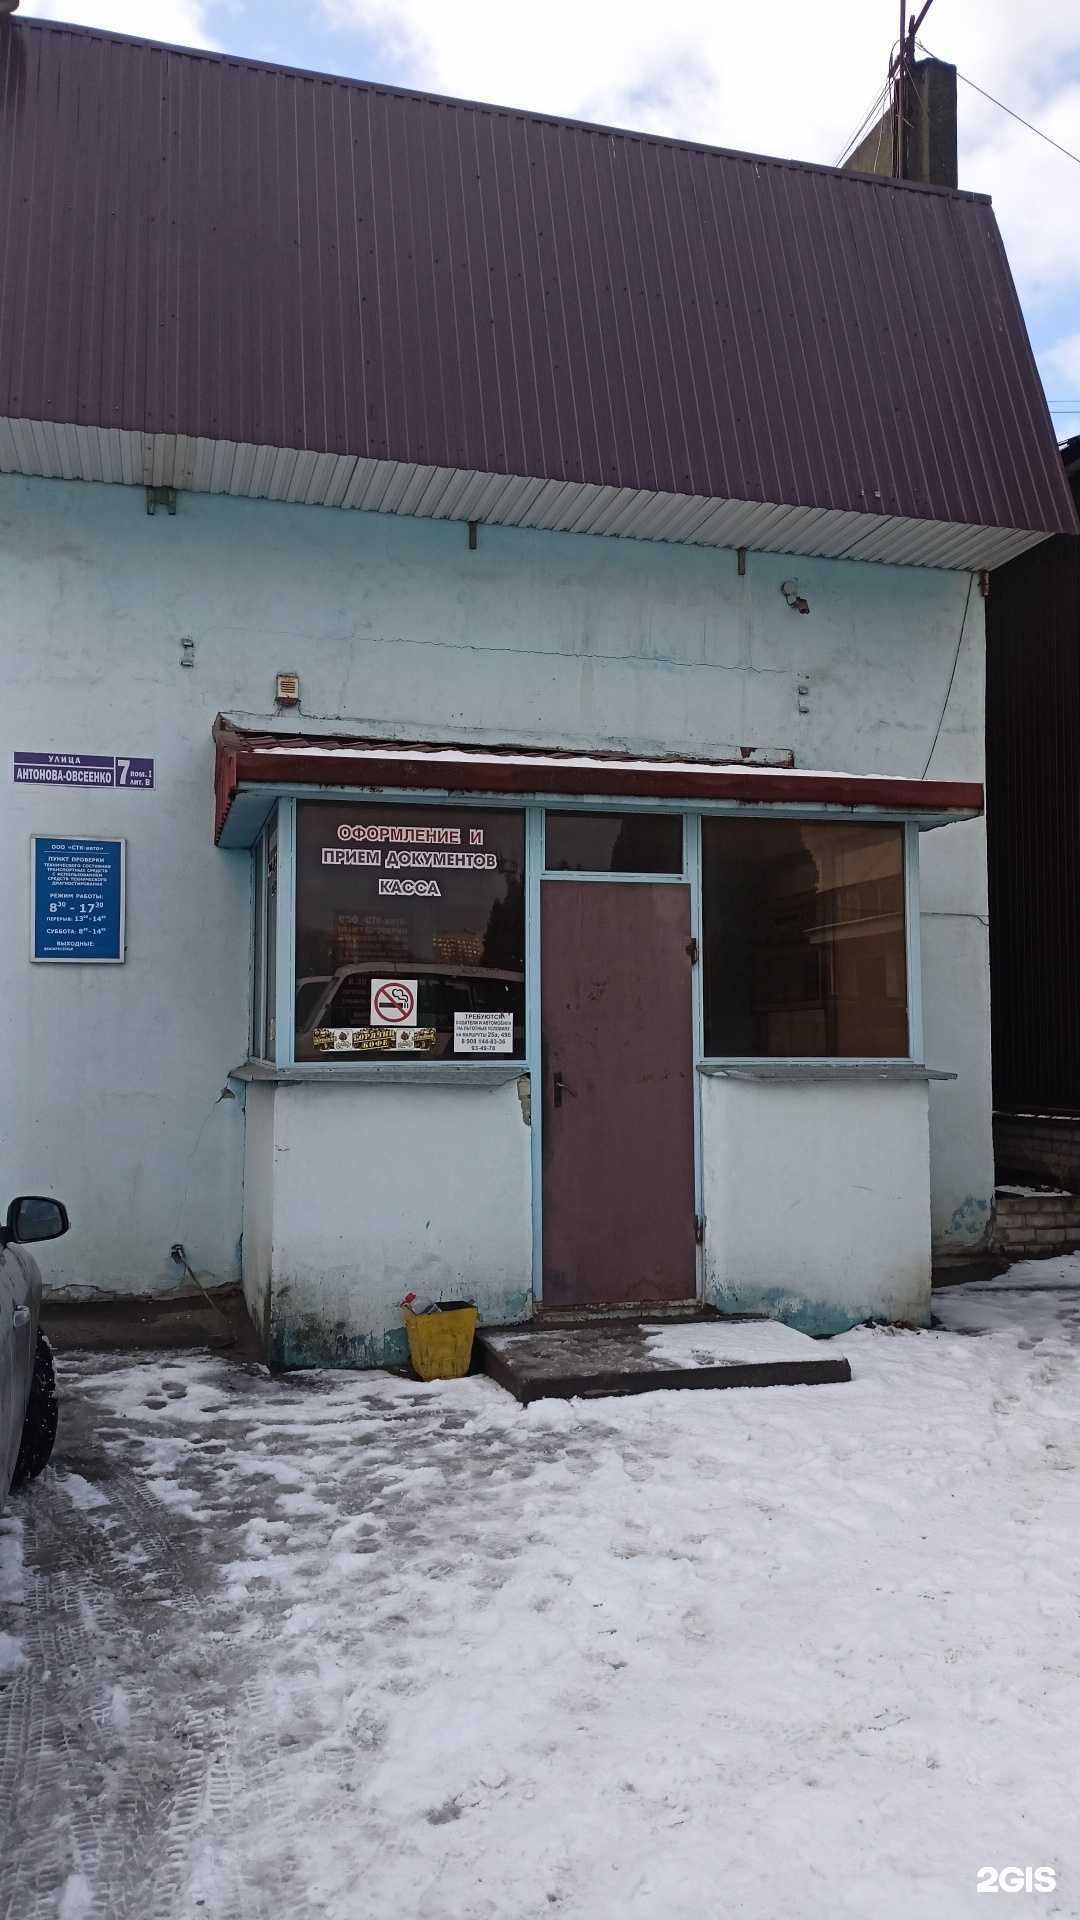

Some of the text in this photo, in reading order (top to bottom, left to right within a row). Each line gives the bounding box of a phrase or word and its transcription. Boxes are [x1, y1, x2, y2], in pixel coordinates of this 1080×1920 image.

[48, 755, 81, 764] УЛИЦА
[16, 767, 112, 784] АНТОНОВА-ОВСЕЕНКО
[117, 759, 130, 785] 7
[337, 825, 484, 845] ОФОРМЛЕНИЕ И
[322, 848, 497, 870] ПРИЕМ ДОКУМЕНТОВ
[378, 879, 441, 897] КАССА
[361, 1039, 388, 1049] КОФЕ
